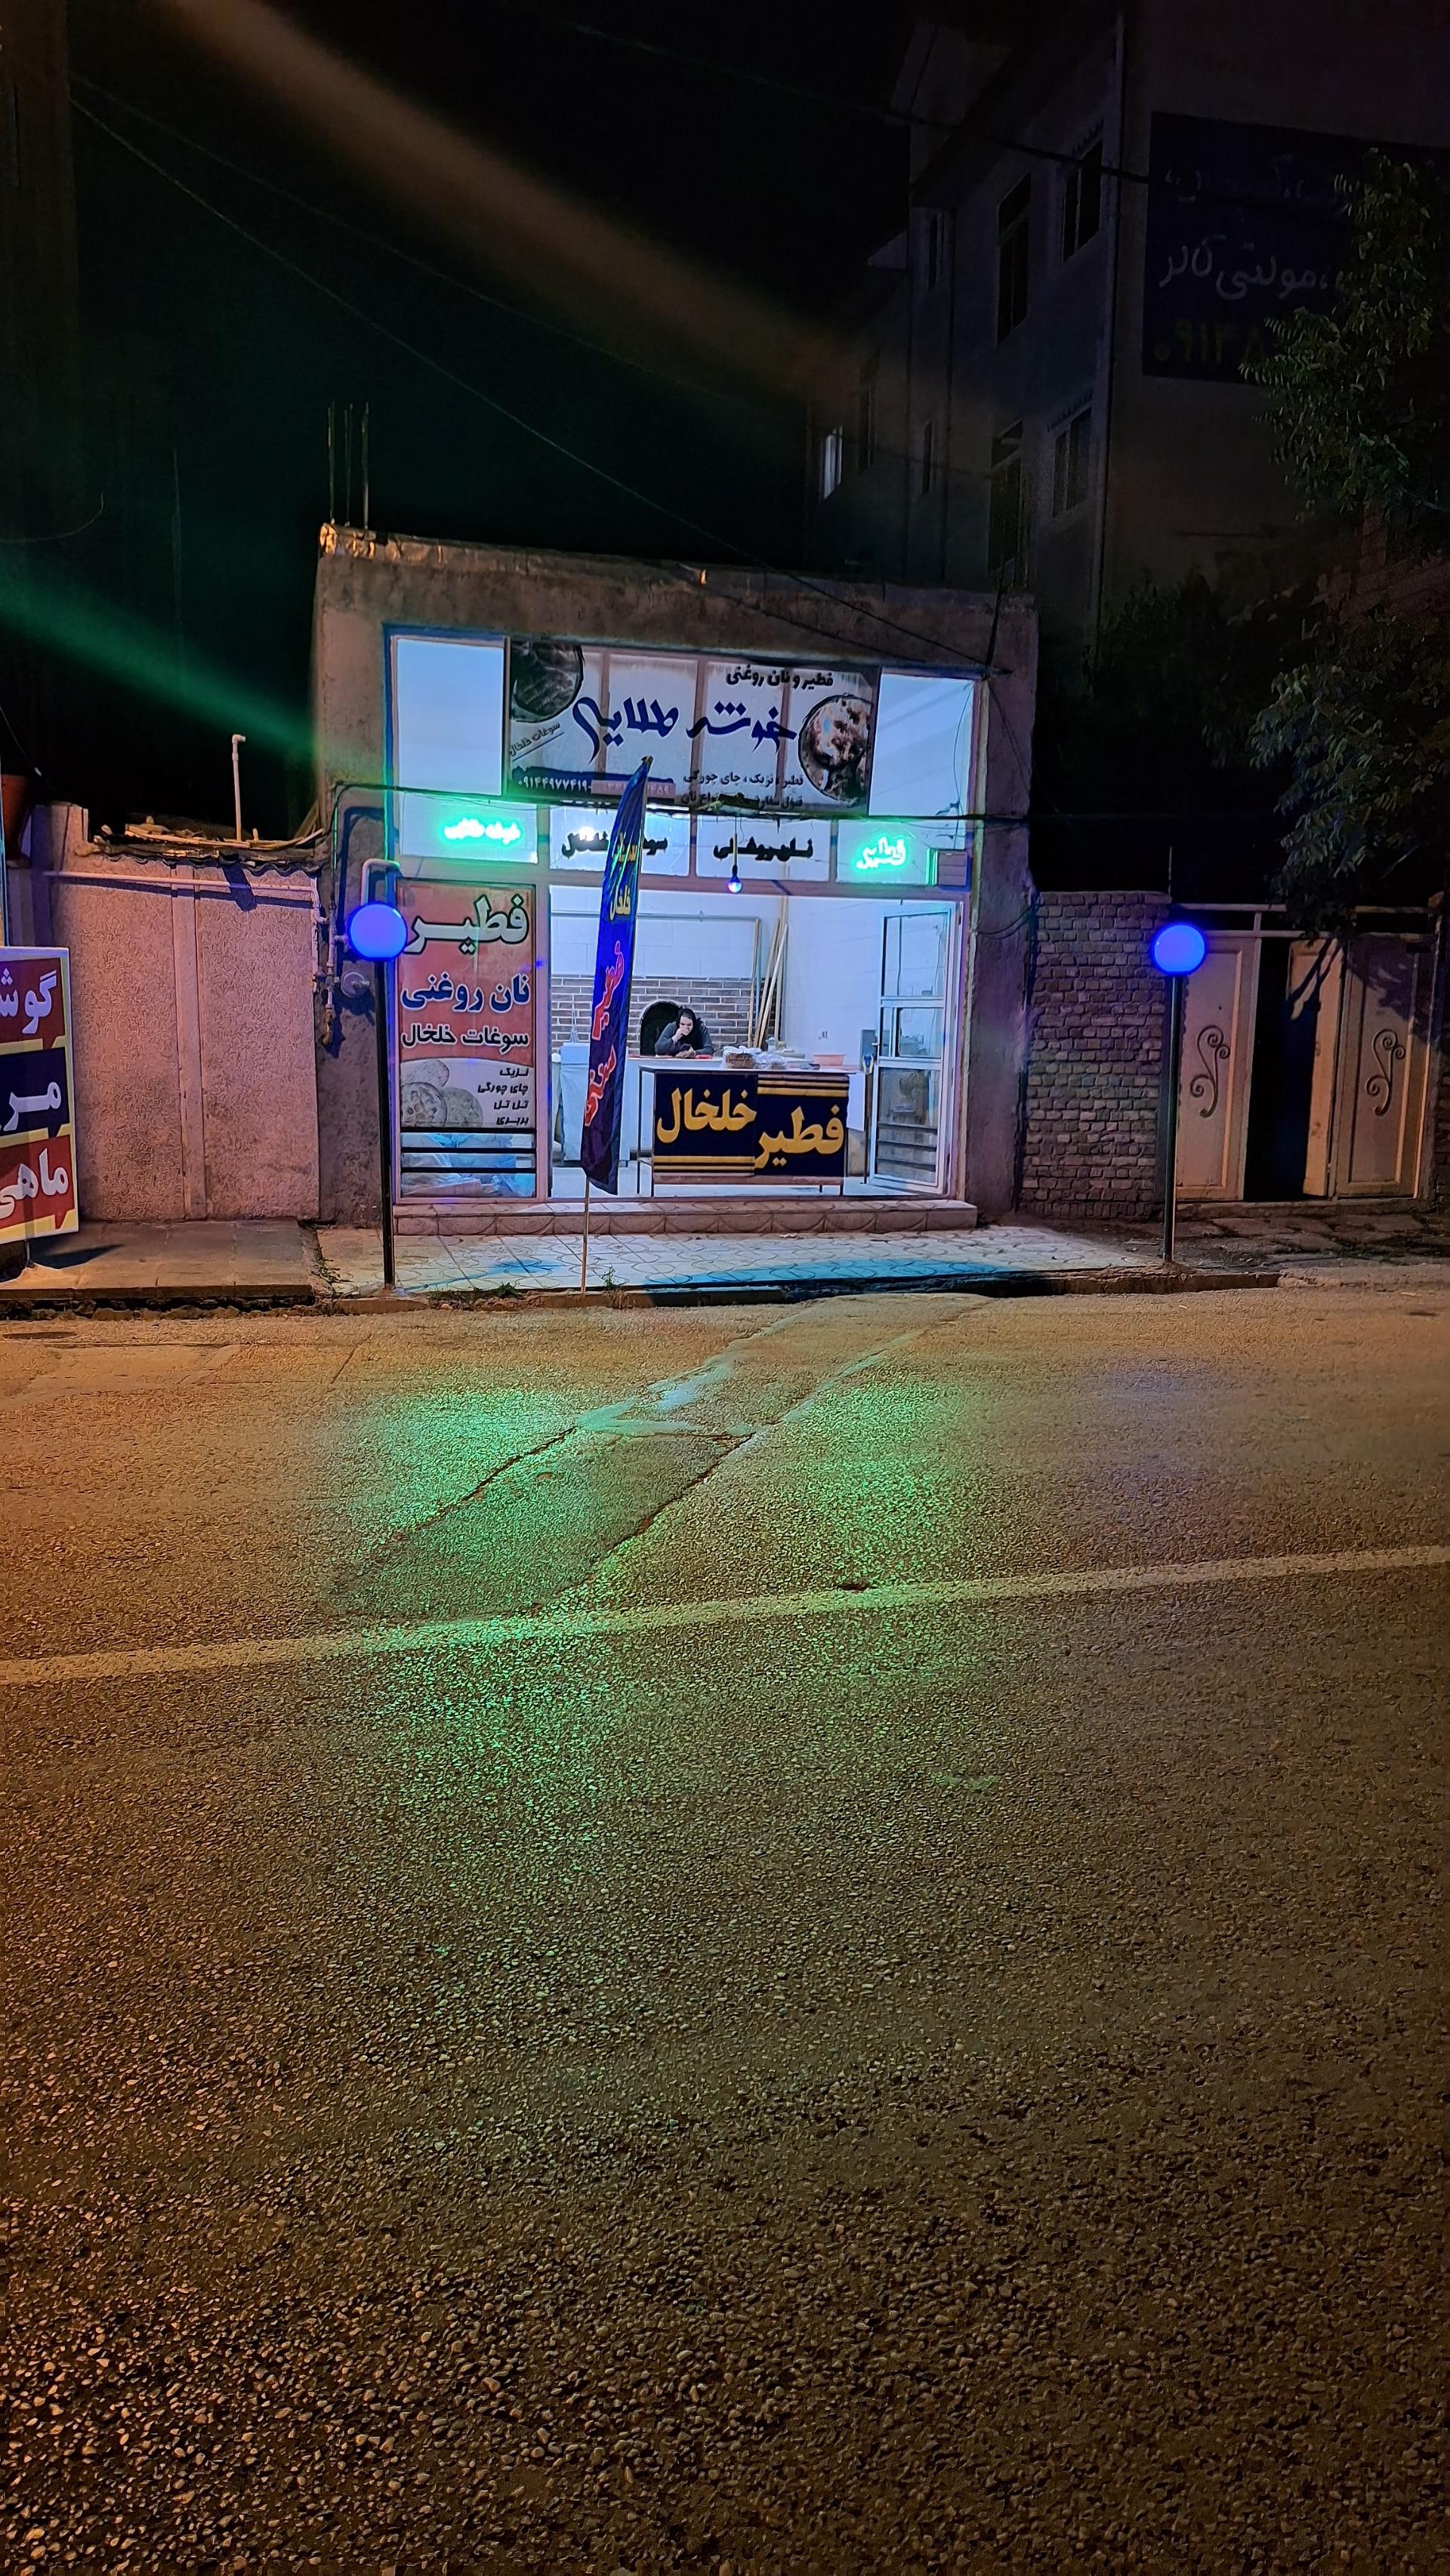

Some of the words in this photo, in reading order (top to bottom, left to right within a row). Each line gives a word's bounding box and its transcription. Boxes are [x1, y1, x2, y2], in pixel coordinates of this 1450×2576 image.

[726, 664, 764, 688] روغنی
[767, 670, 791, 687] نان
[792, 674, 801, 689] و
[801, 672, 834, 691] فطیر
[532, 722, 561, 741] سوغات
[572, 696, 680, 766] طلایی
[686, 700, 798, 754] خوشه
[509, 737, 532, 757] خلخال
[782, 774, 804, 789] فطیر
[756, 794, 780, 810] سفار
[403, 893, 530, 955] فطیر
[0, 967, 57, 1034] گوش
[401, 972, 484, 1013] روغنی
[489, 973, 531, 1013] نان
[402, 1023, 456, 1048] خلخال
[461, 1026, 529, 1054] سوغات
[510, 1083, 529, 1096] چای
[0, 1081, 62, 1132] مر
[656, 1086, 757, 1144] خلخال
[755, 1104, 845, 1169] فطیر
